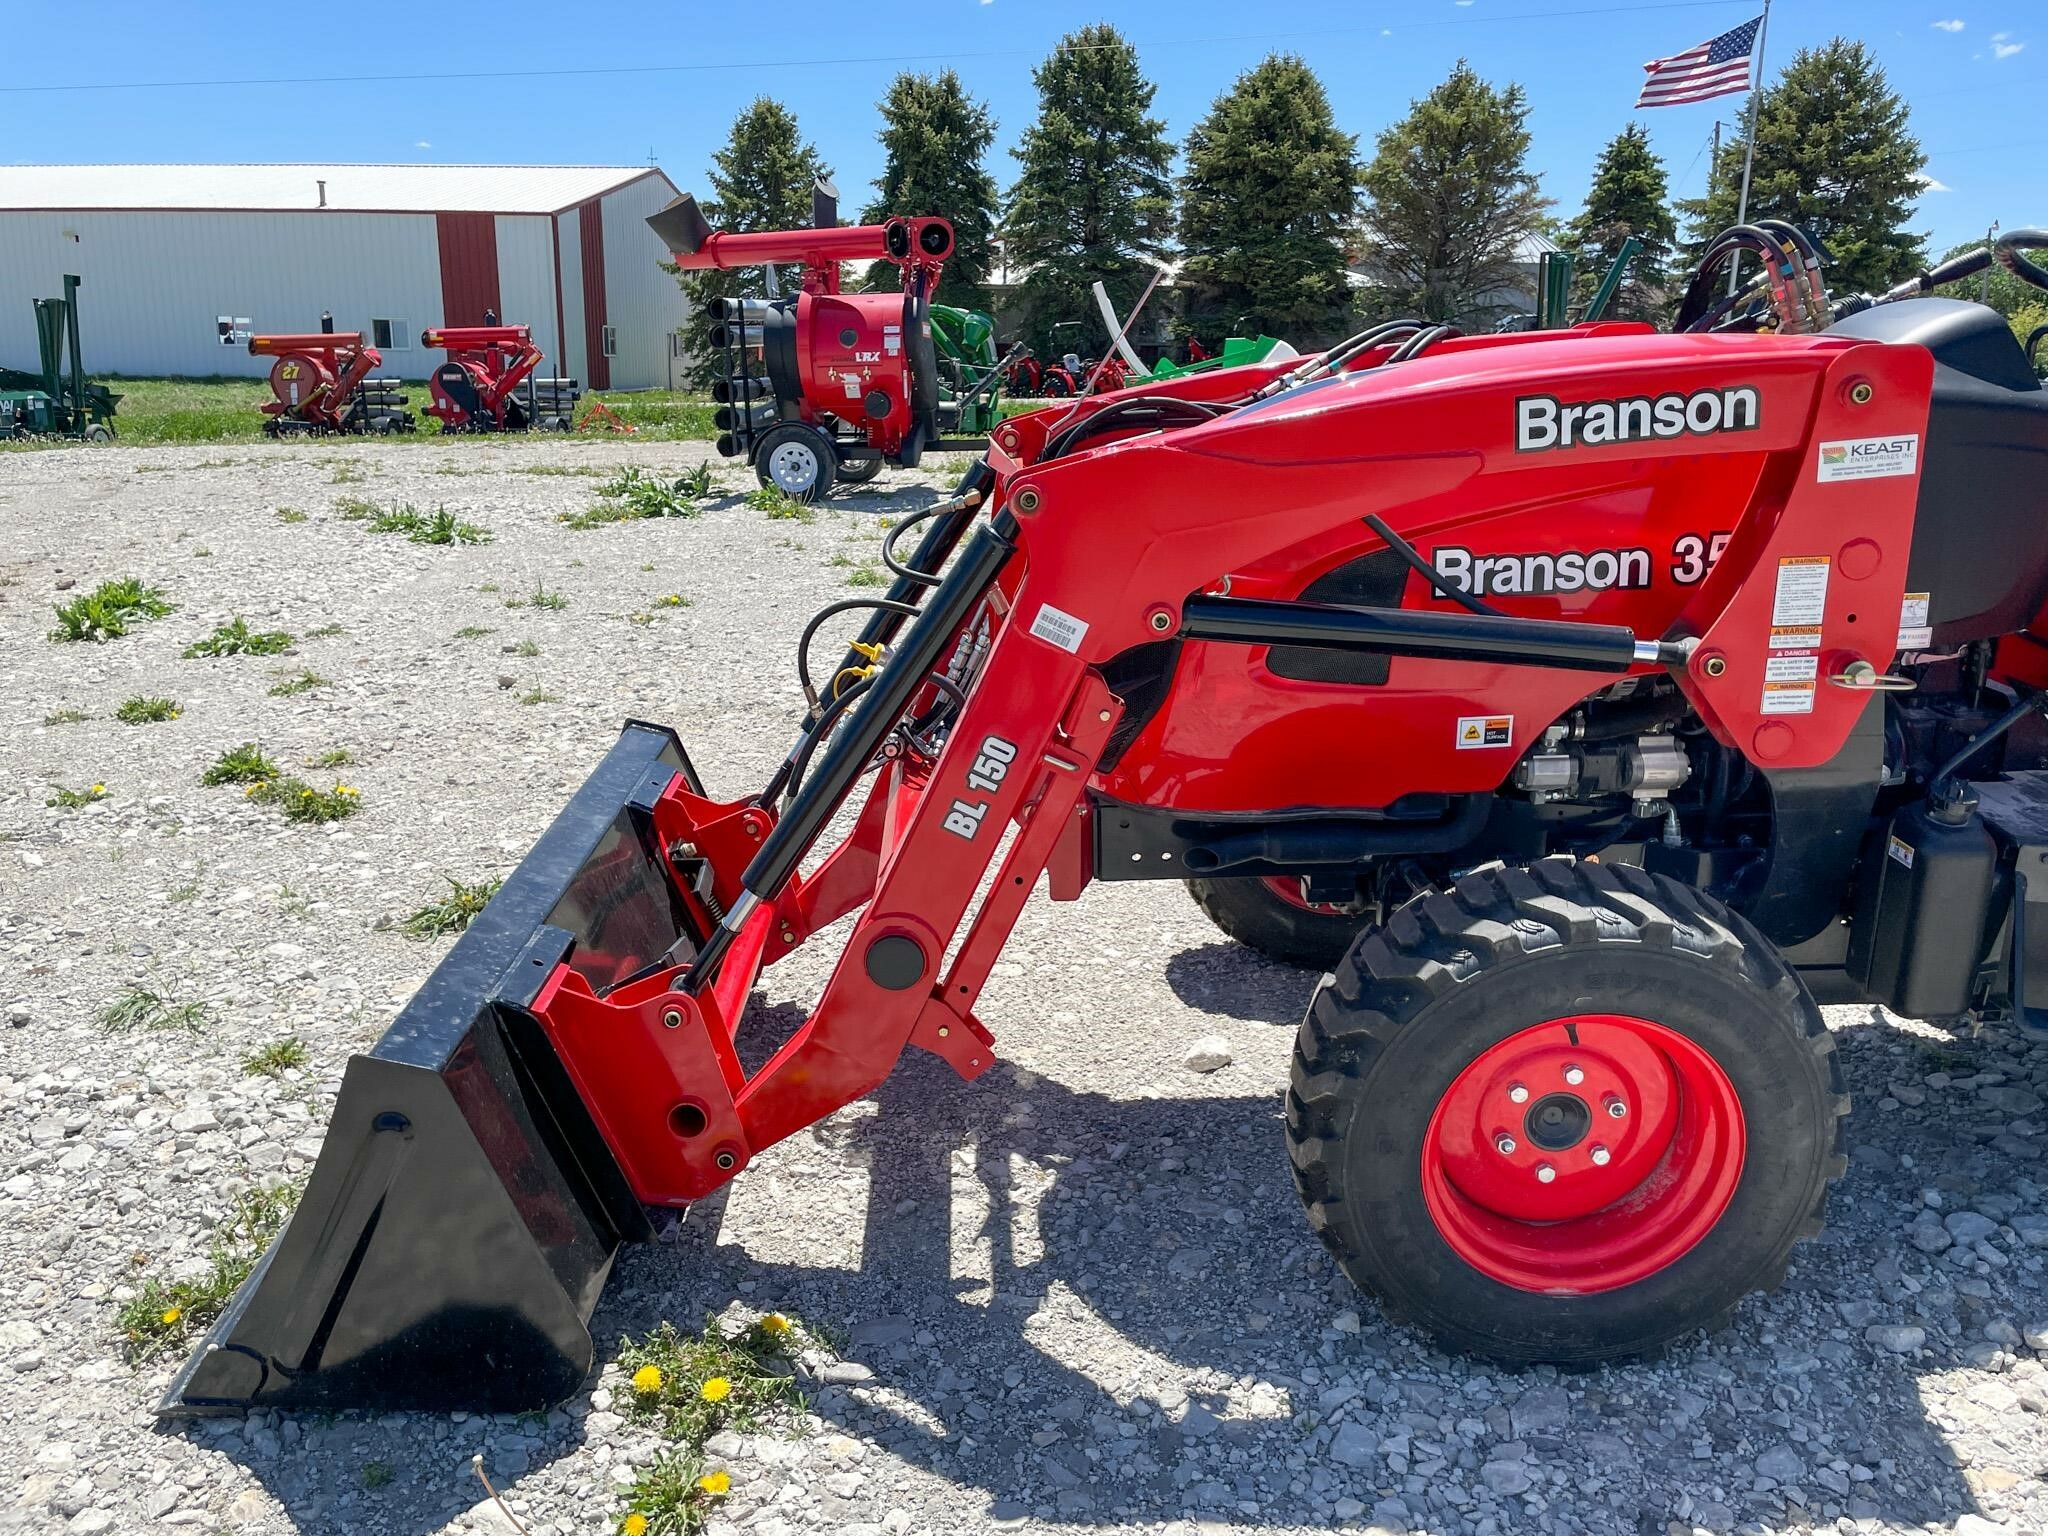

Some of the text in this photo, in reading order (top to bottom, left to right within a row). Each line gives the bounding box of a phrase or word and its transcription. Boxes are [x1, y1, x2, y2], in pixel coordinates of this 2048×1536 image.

[282, 366, 300, 380] 27
[1517, 388, 1758, 450] Branson
[1851, 439, 1916, 457] KEAST
[1850, 453, 1900, 464] ENTERPRISES
[1434, 549, 1649, 597] Branson
[1782, 626, 1819, 635] WARNING
[1784, 649, 1811, 657] DANGER
[943, 736, 1017, 840] BL 150
